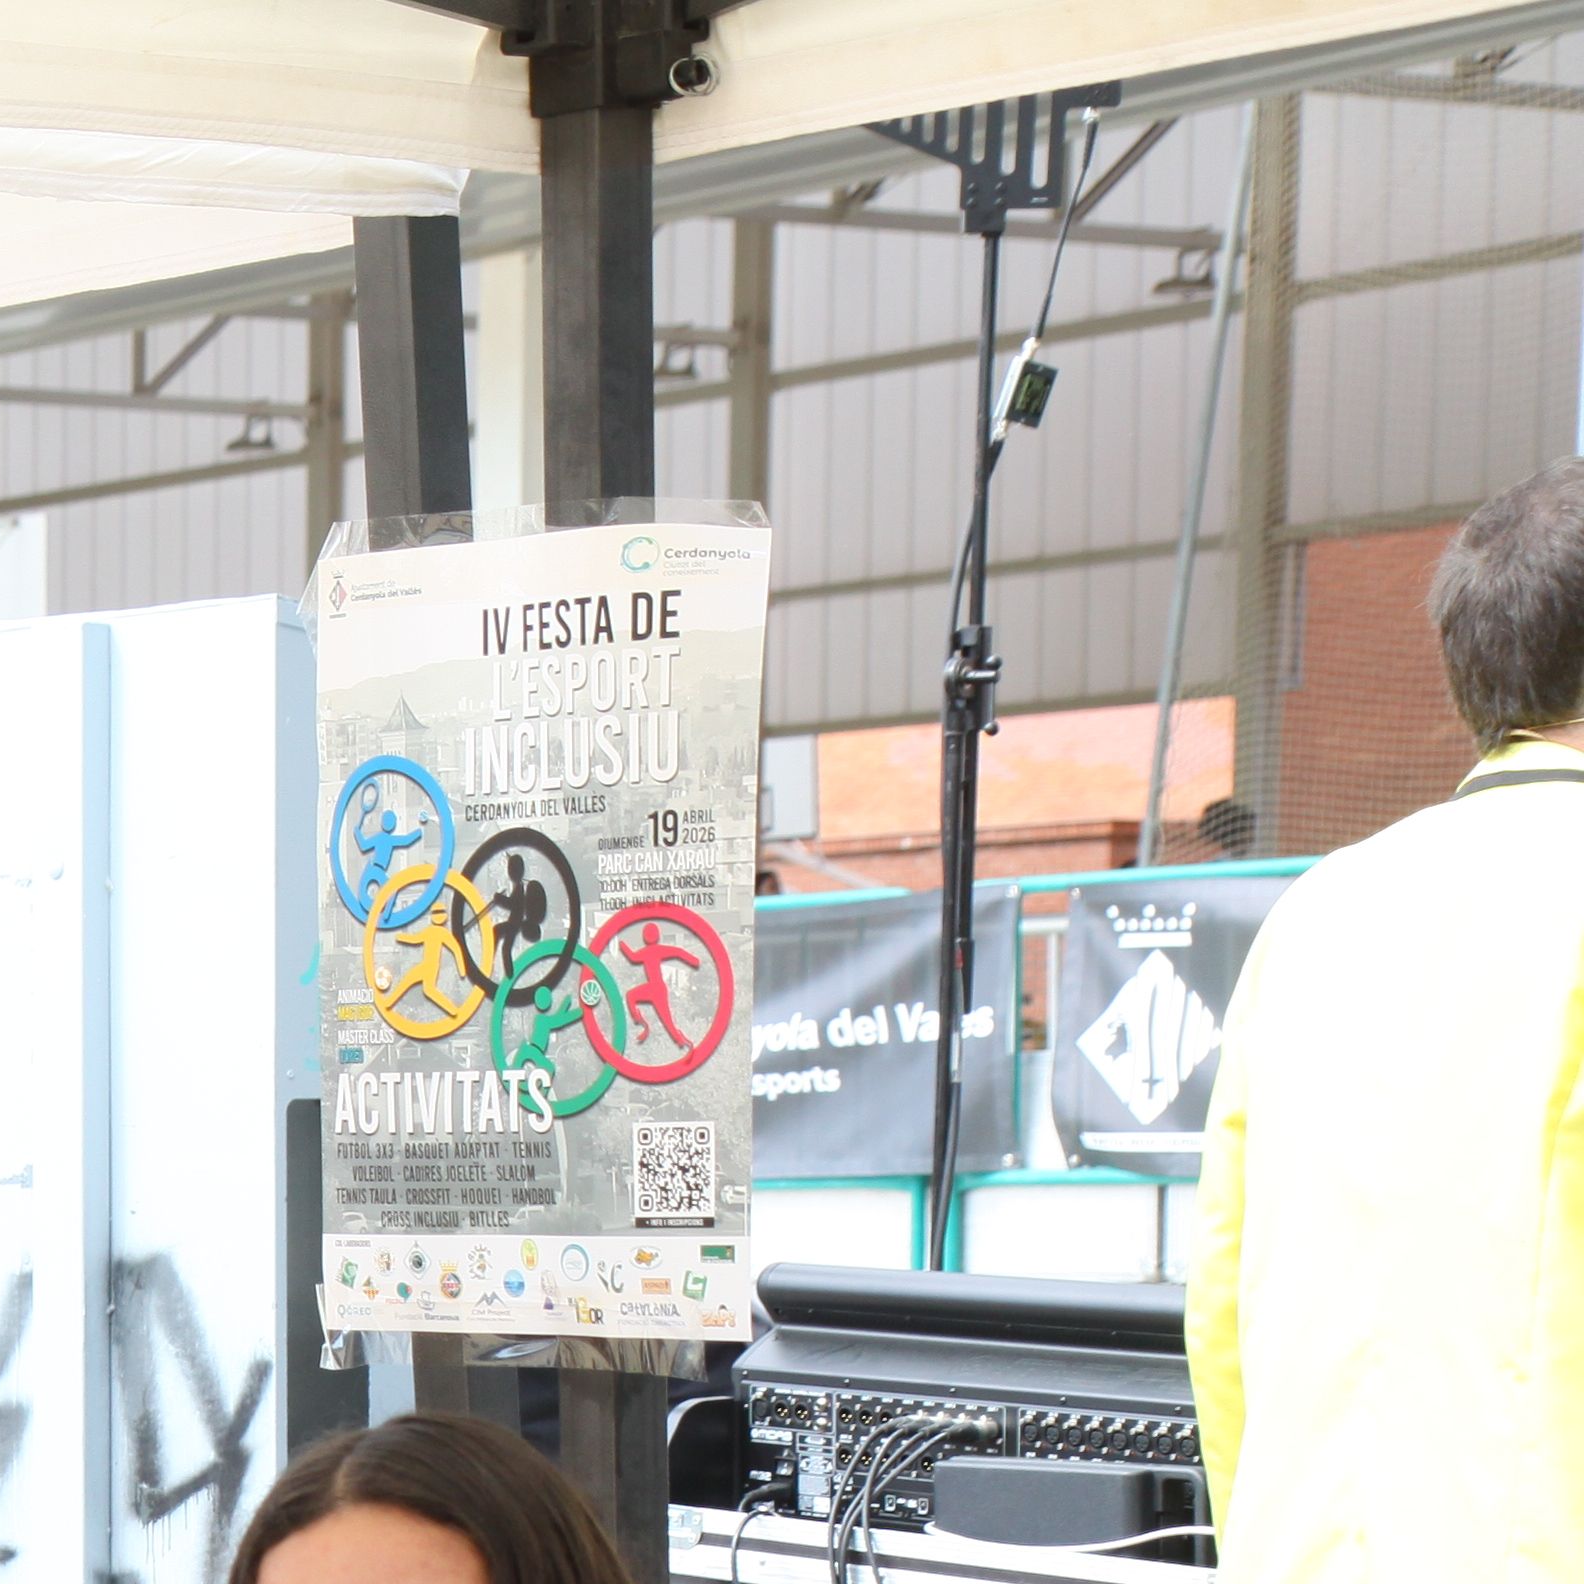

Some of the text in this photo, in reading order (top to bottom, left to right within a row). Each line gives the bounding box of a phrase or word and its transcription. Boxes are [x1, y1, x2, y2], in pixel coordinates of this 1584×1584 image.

[663, 547, 751, 562] Cerdanyola
[483, 589, 682, 656] IV FESTA DE
[492, 645, 682, 722] L'ESPORT
[464, 710, 680, 796] INCLUSIU
[465, 791, 607, 822] CERDANYOLA DEL VALLÈS
[598, 827, 716, 850] DIUMENGE 2026
[647, 808, 716, 847] 19 ABRIL
[598, 848, 716, 875] PARC CAN XARAU
[631, 875, 672, 891] ENTREGA
[674, 872, 716, 889] DORSALS
[657, 890, 715, 907] ACTIVITATS
[337, 1029, 394, 1044] MASTER CLASS
[827, 1006, 887, 1049] del
[751, 1066, 841, 1101] sports
[335, 1068, 554, 1135] ACTIVITATS
[337, 1141, 372, 1159] FUTBOL
[375, 1141, 394, 1159] 3X3
[454, 1141, 501, 1159] ADAPTAT
[512, 1141, 552, 1159] TENNIS
[352, 1164, 395, 1182] VOLEIBOL
[403, 1164, 442, 1182] CADIRES
[336, 1188, 557, 1206] TENNIS TAULA CROSSFIT HOQUEI HANDBOL
[381, 1210, 510, 1228] CROSS INCLUSIU BITLLES
